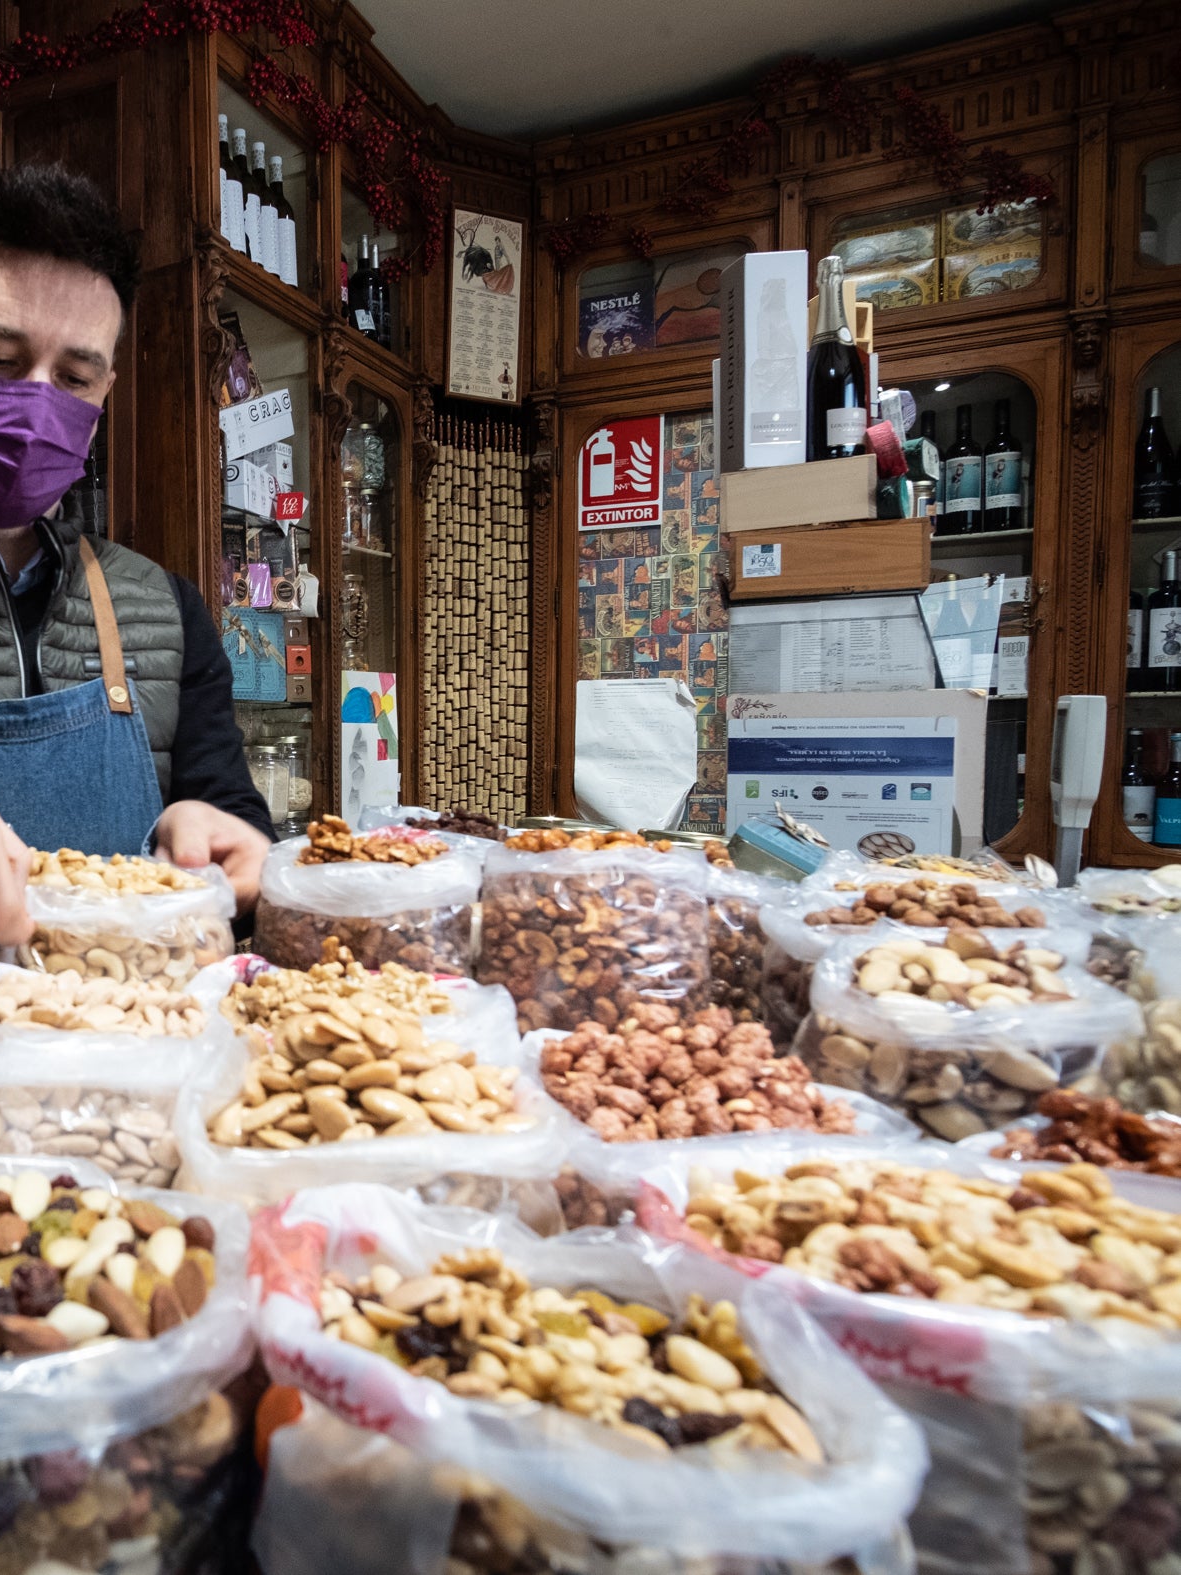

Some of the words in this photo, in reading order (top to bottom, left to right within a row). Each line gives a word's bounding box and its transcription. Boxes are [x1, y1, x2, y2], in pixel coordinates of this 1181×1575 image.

[590, 292, 641, 312] NESTLÉ
[726, 288, 734, 390] ROEDERER
[726, 395, 734, 450] LOUIS
[586, 508, 652, 524] EXTINTOR
[652, 580, 661, 619] SANGUINETTI
[771, 789, 788, 798] IFS
